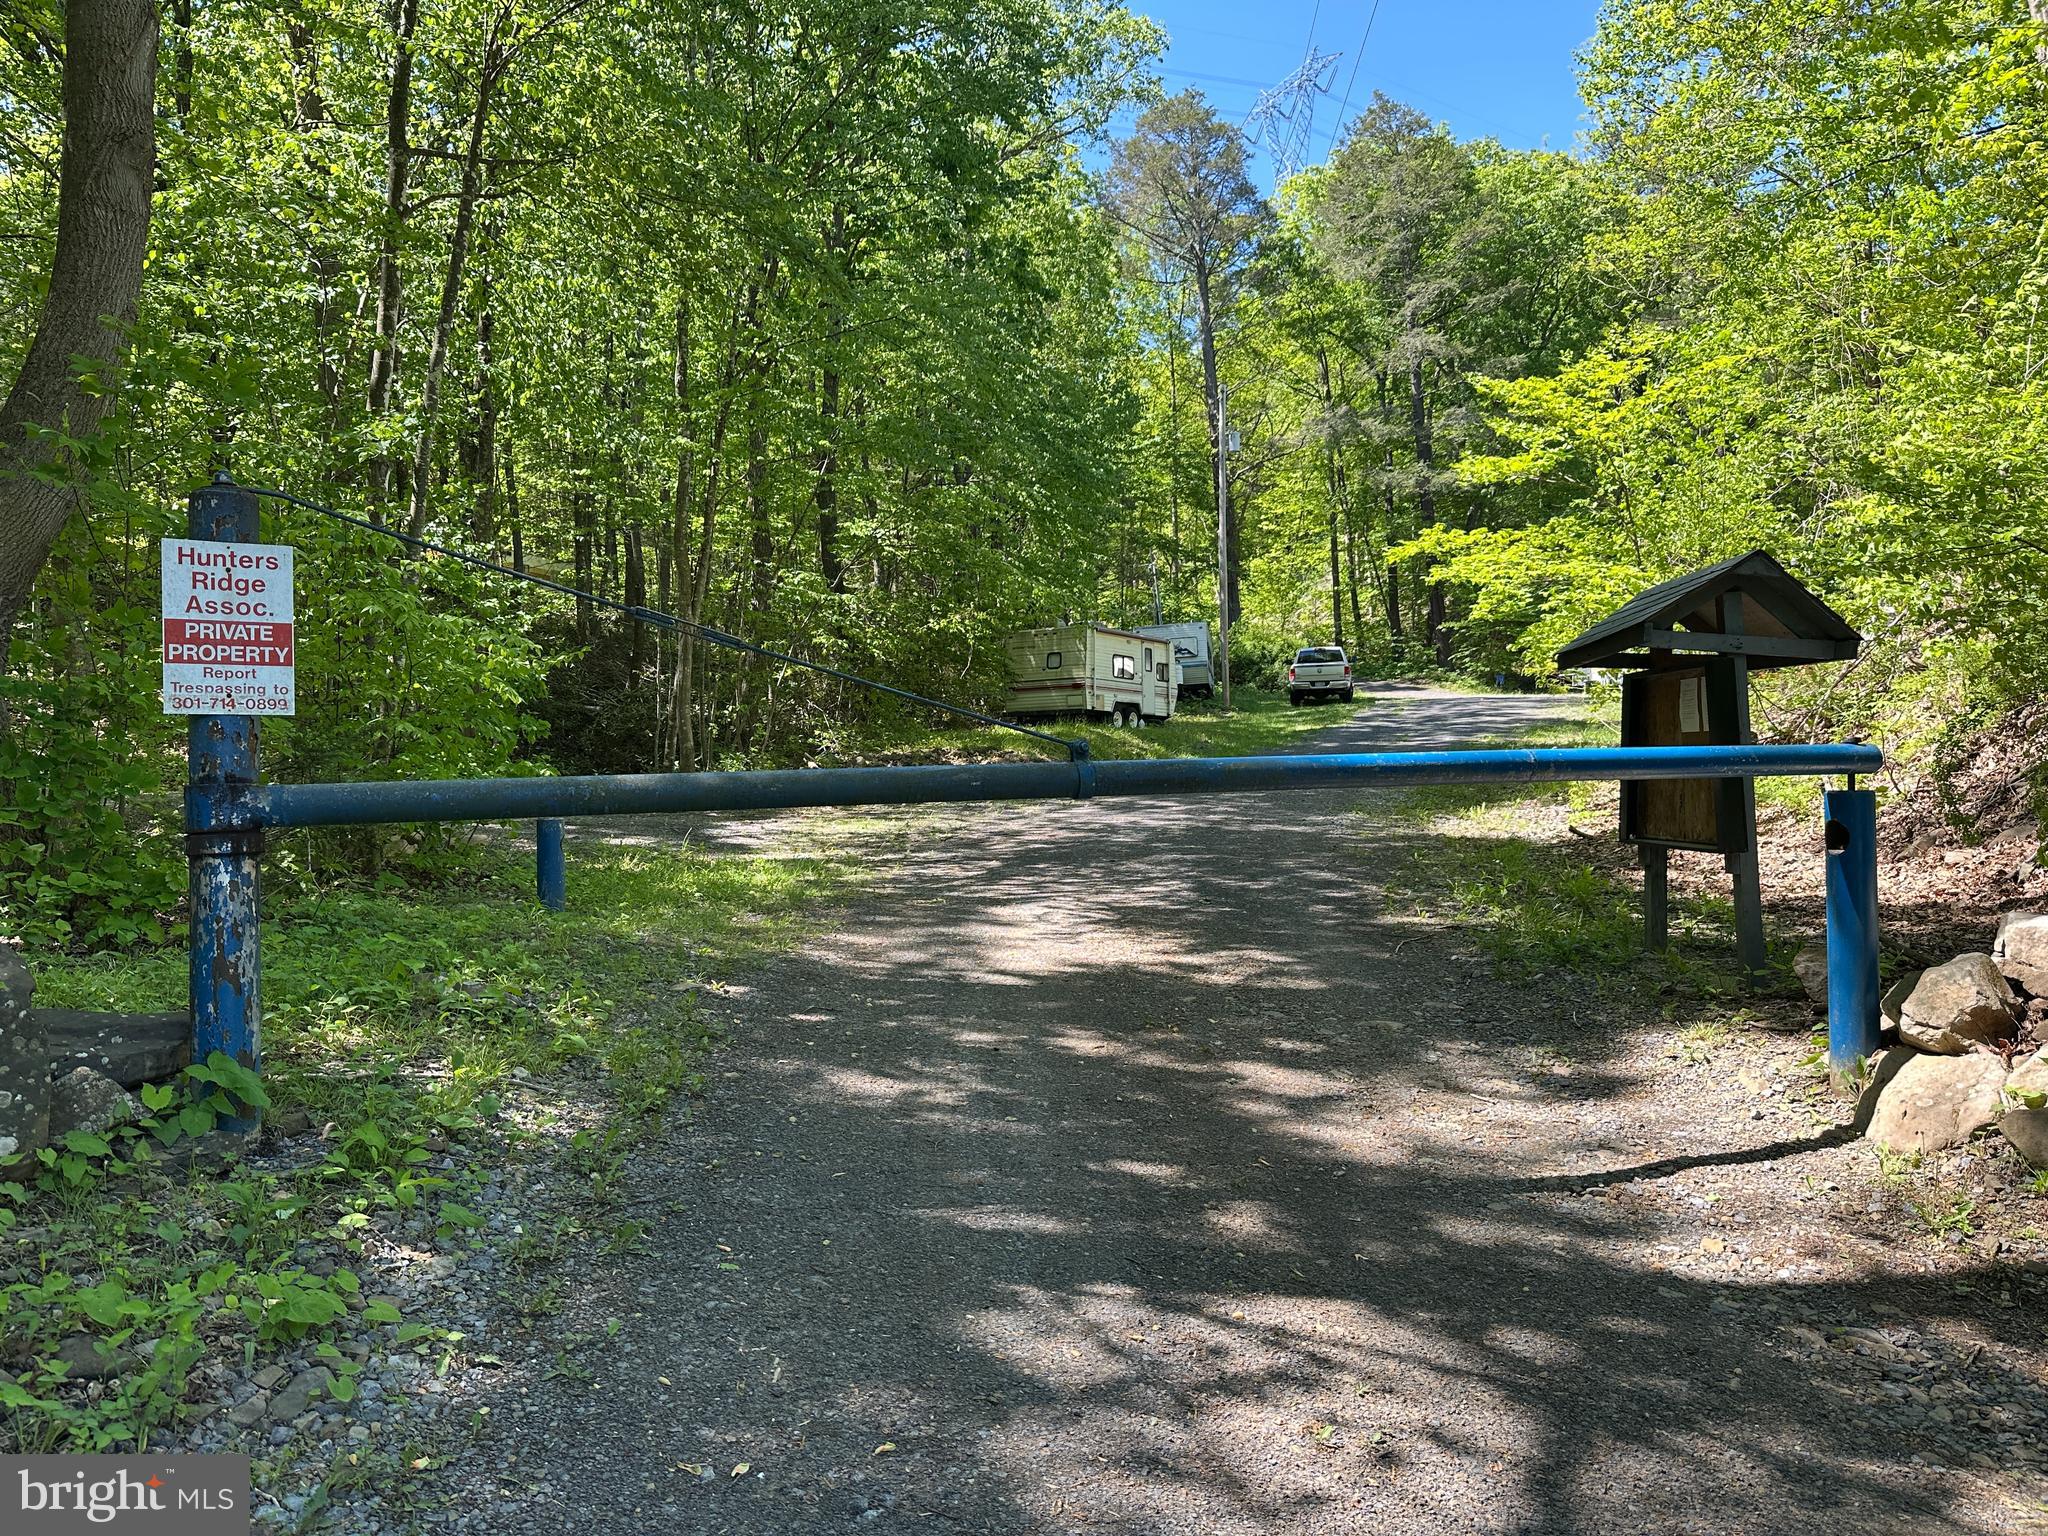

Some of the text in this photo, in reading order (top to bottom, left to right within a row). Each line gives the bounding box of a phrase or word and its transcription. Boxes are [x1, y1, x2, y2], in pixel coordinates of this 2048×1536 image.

[177, 546, 279, 570] Hunters
[191, 571, 266, 596] Ridge
[185, 595, 274, 617] Assoc.
[185, 622, 273, 642] PRIVATE
[168, 643, 289, 663] PROPERTY
[203, 667, 257, 681] Report
[170, 681, 289, 696] Trespassing to
[172, 697, 288, 710] 301-714-0899
